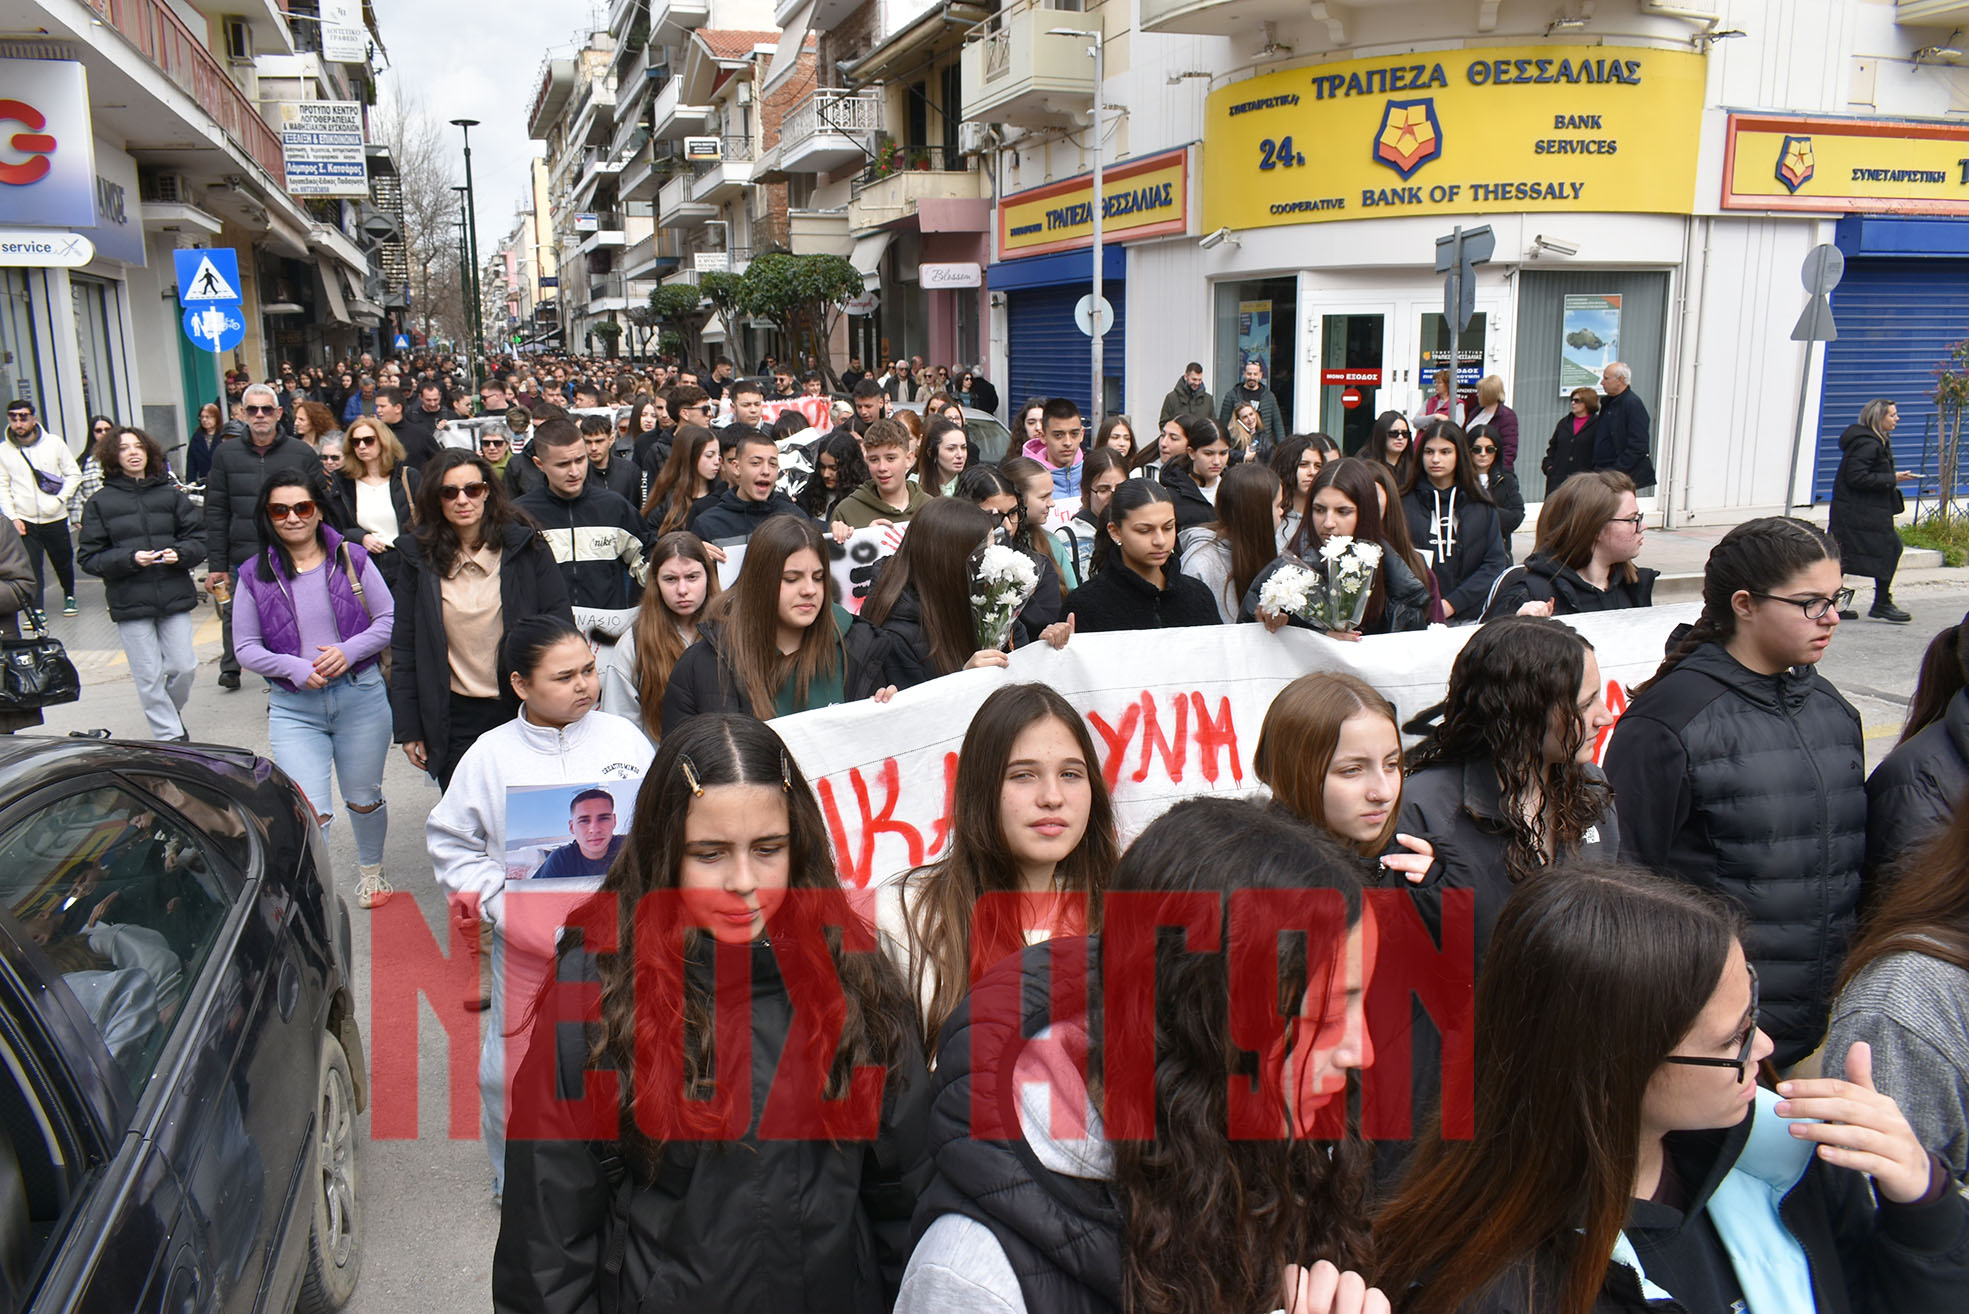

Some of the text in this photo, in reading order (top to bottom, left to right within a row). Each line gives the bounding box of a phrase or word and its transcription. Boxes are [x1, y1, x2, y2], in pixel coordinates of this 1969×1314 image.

[1312, 58, 1642, 100] ΤΡΑΠΕΖΑ ΘΕΣΣΑΛΙΑΣ
[299, 104, 359, 116] ΠΡΟΤΥΠΟ ΚΕΝΤΡΟ
[300, 115, 356, 124] ΛΟΓΟΘΕΡΑΠΕΙΑΣ
[1554, 114, 1602, 130] BANK
[1534, 139, 1618, 155] SERVICES
[1852, 168, 1946, 183] ΣΥΝΕΤΑΙΡΙΣΤΙΚΗ
[1270, 181, 1585, 215] COOPERATIVE BANK OF THESSALY
[1046, 201, 1095, 231] ΤΡΑΠΕΖΑ
[2, 241, 52, 253] service
[1346, 373, 1378, 381] ΕΞΟΔΟΣ
[577, 614, 621, 627] ΝΑΣΙΟ
